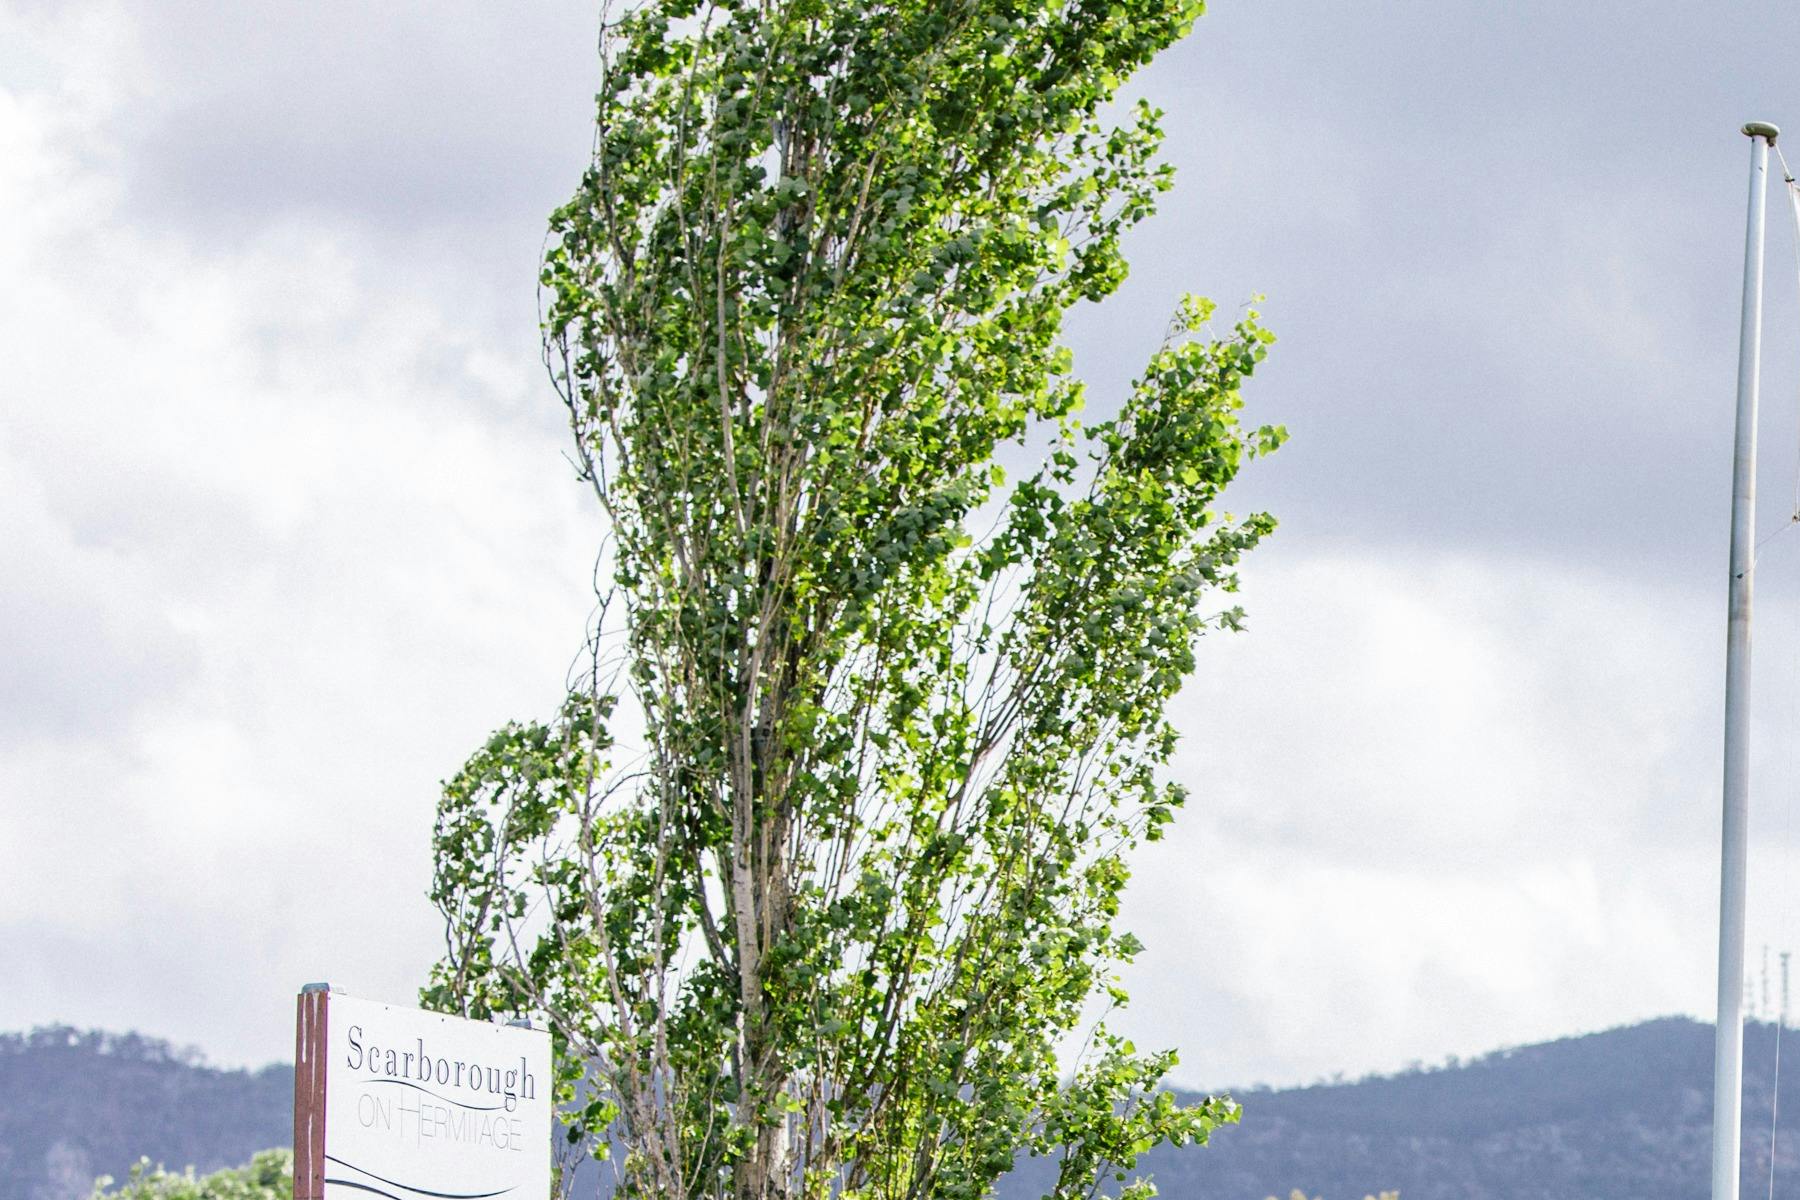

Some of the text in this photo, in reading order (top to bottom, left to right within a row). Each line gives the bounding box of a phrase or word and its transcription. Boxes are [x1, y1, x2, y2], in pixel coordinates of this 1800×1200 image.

[346, 1025, 536, 1113] Scarborough
[357, 1087, 523, 1152] ON HERMITAGE
